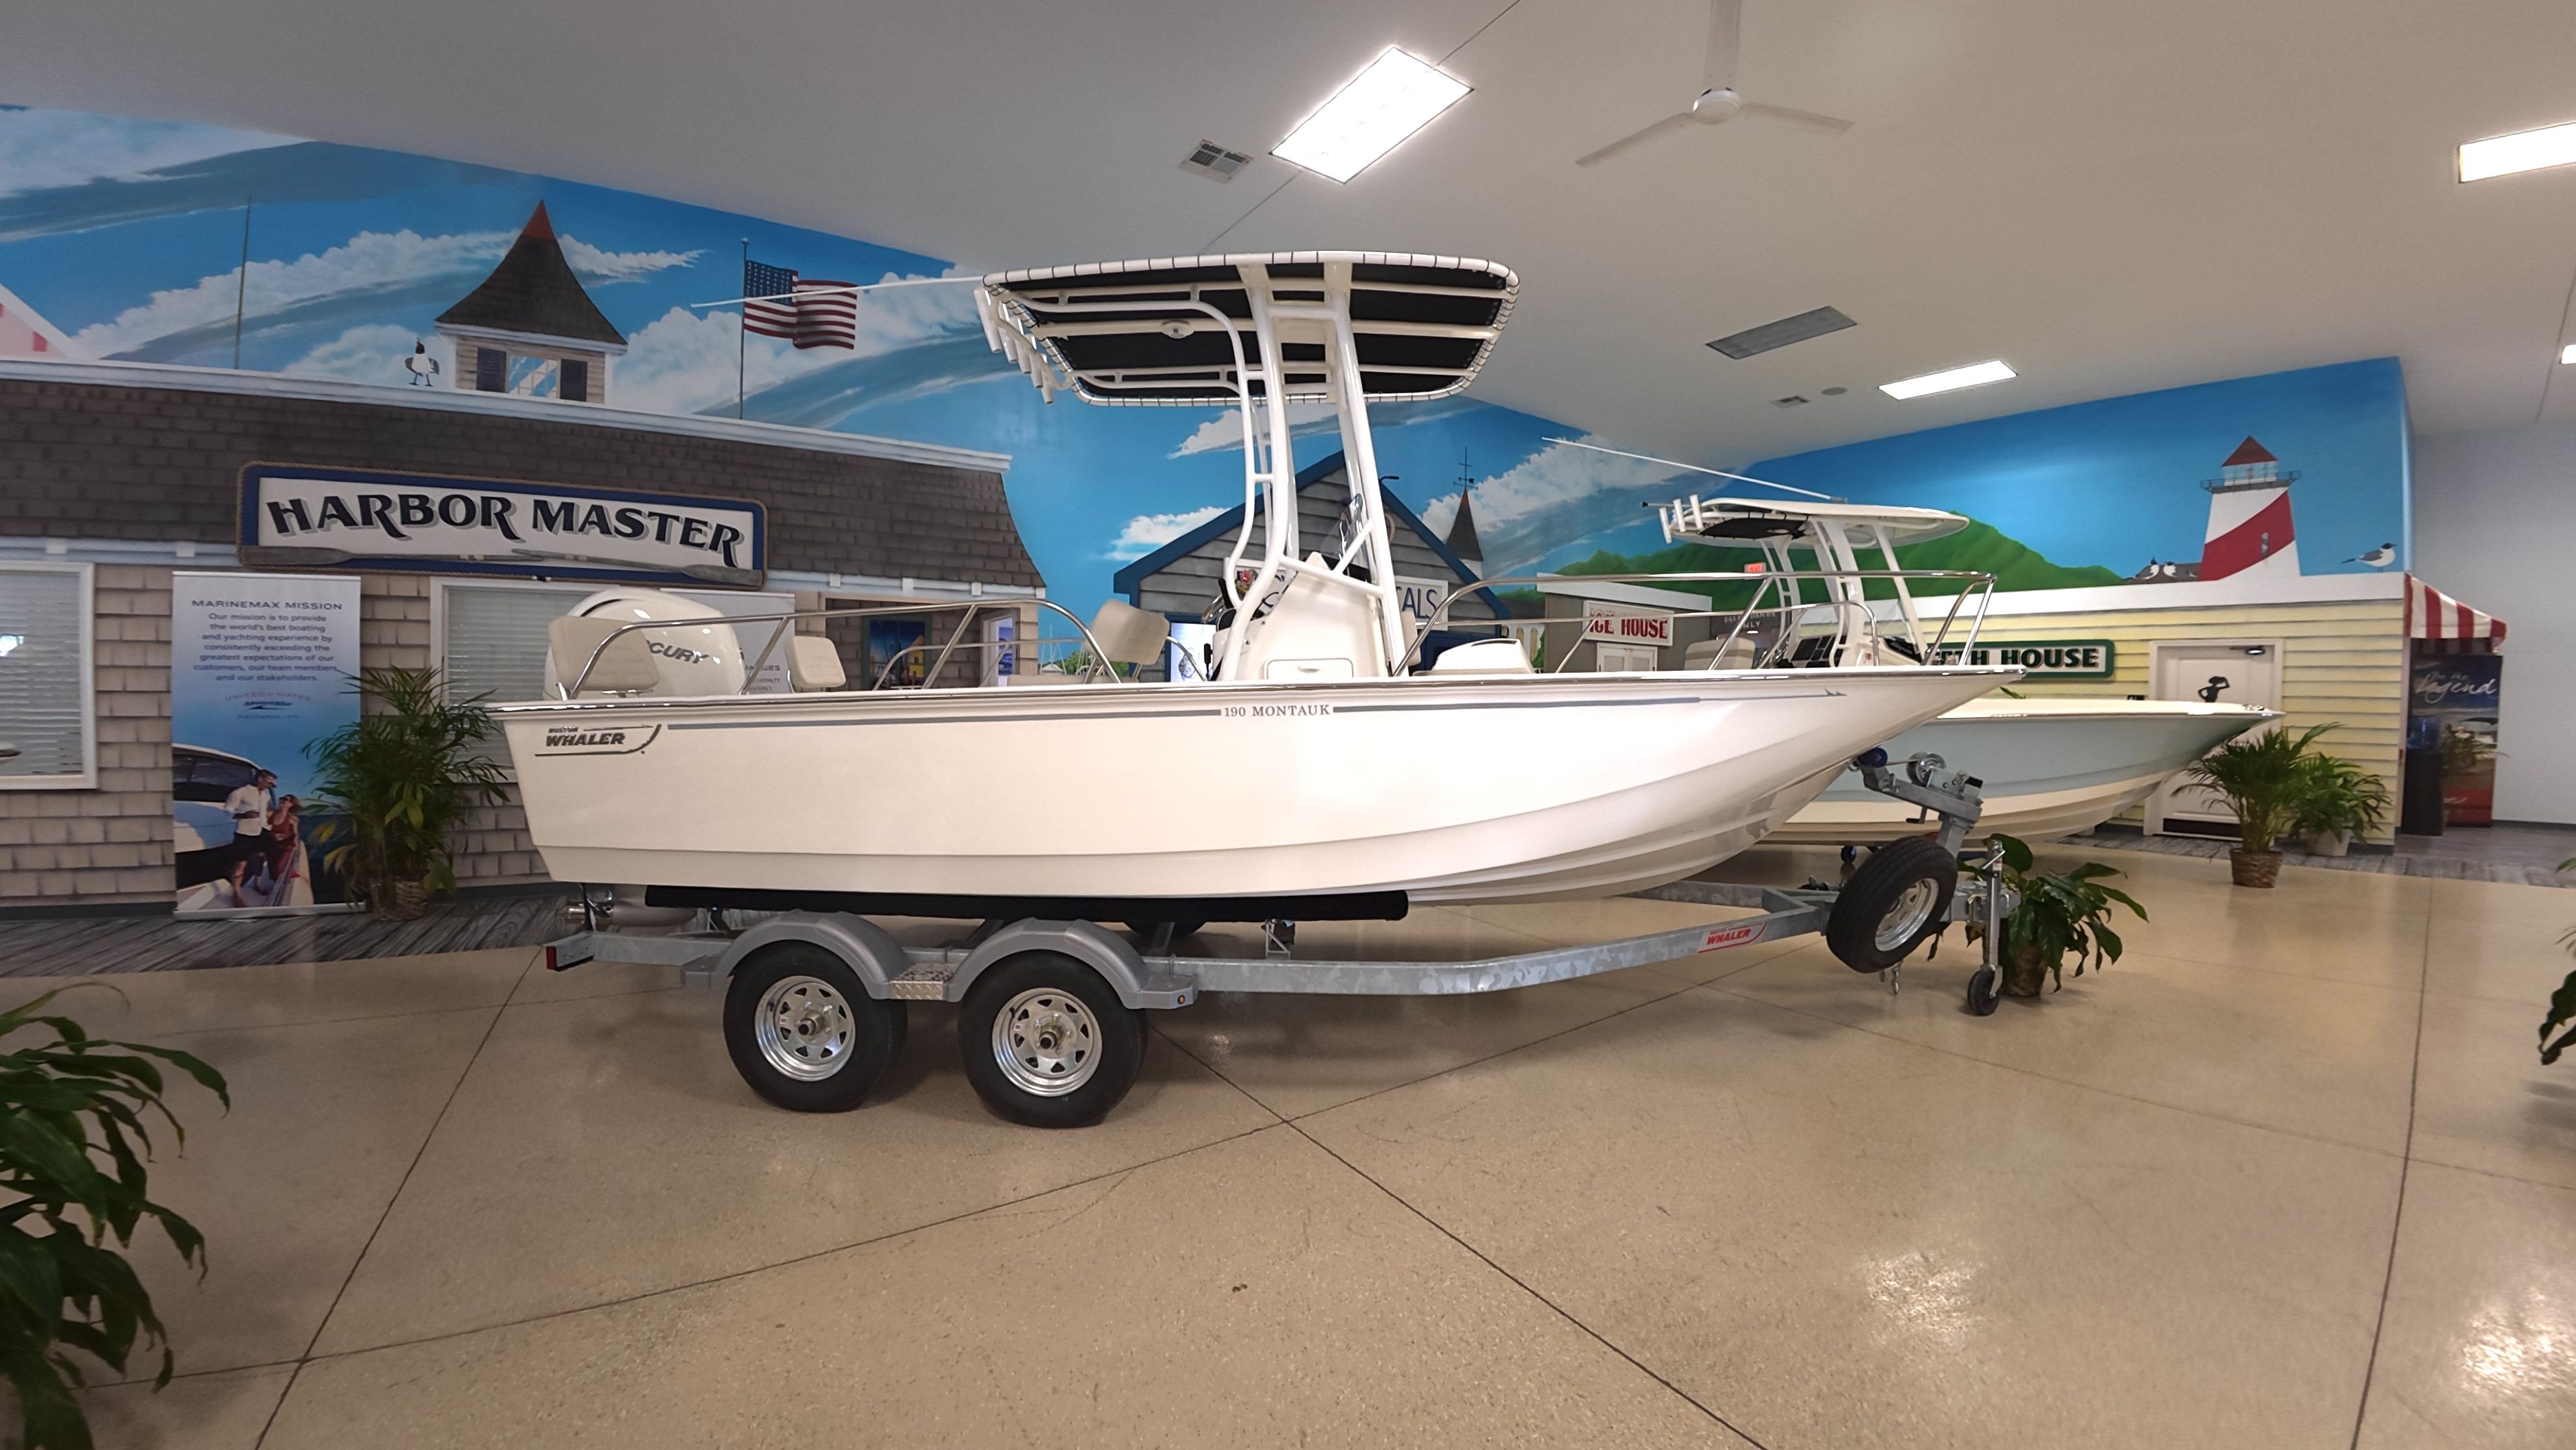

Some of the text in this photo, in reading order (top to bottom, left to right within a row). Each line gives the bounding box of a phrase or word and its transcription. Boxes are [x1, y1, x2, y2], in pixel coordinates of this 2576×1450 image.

[266, 494, 741, 569] HARBOR MASTER
[192, 600, 342, 610] MARINEMAX MISSION
[1396, 586, 1437, 619] ALS
[291, 614, 327, 623] provide
[289, 625, 326, 634] boating
[1621, 617, 1668, 640] HOUSE
[224, 634, 265, 642] yachting
[268, 634, 319, 643] experience
[321, 635, 333, 644] by
[646, 640, 709, 664] CURY
[2000, 648, 2100, 668] HOUSE
[2415, 674, 2497, 704] Legend
[1224, 704, 1330, 717] 190 MONTAUK
[546, 732, 626, 747] WHALER
[1706, 928, 1751, 945] WHALER
